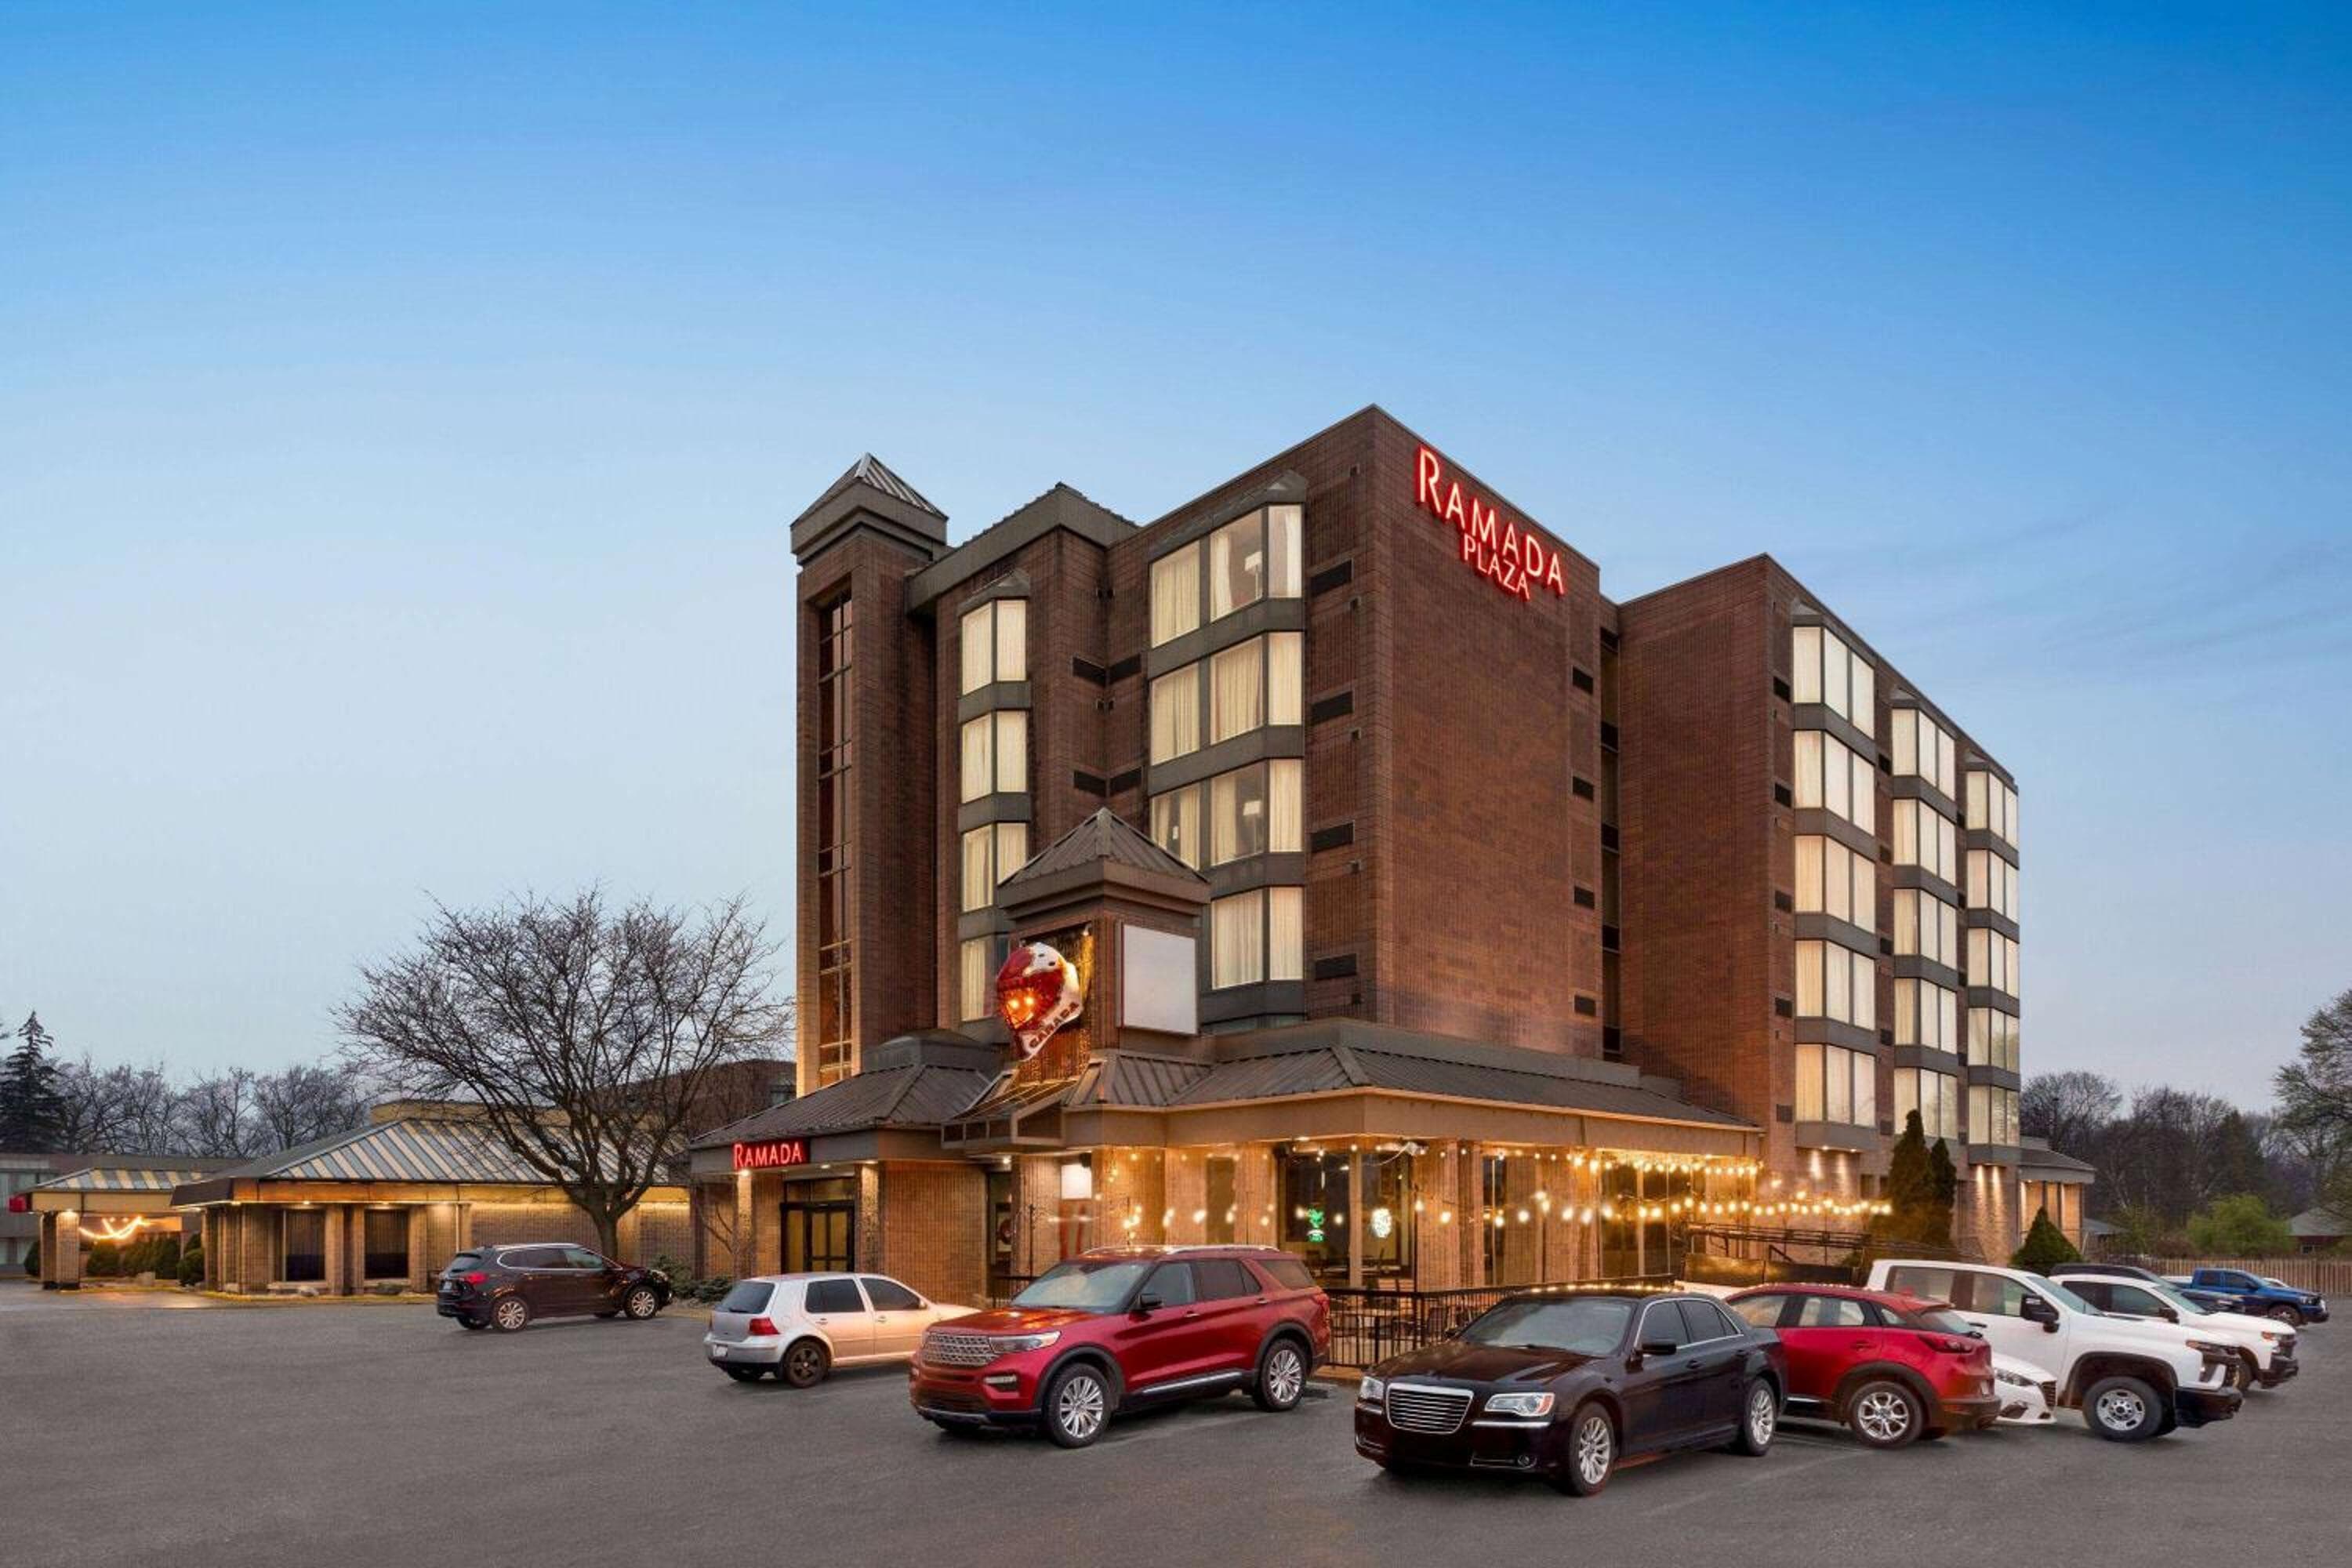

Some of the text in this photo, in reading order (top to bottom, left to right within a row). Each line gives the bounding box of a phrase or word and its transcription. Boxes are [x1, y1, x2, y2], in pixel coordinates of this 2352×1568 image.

[1416, 445, 1565, 596] RAMADA
[1461, 532, 1530, 601] PLAZA
[733, 1142, 802, 1168] RAMADA
